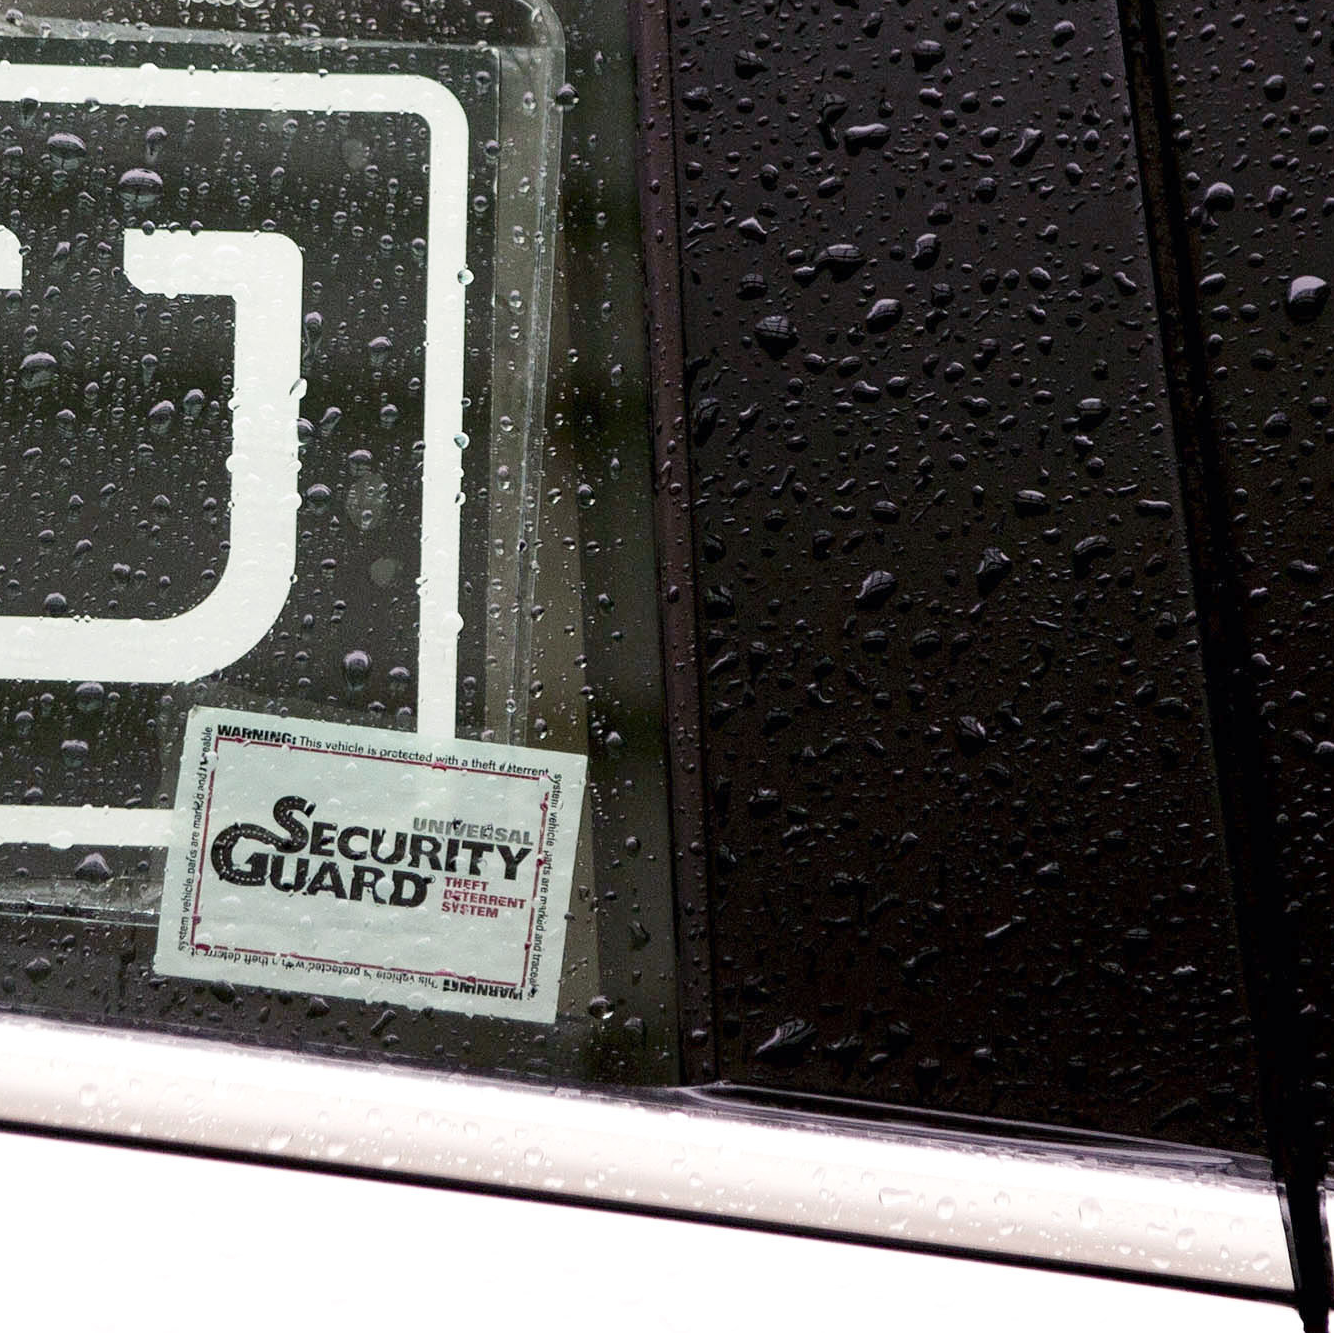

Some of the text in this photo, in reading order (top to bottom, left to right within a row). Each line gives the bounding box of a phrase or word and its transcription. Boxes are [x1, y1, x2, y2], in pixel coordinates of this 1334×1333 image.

[217, 724, 297, 745] WARNING:
[300, 735, 322, 749] This
[325, 740, 364, 754] vehicle
[367, 744, 377, 756] is
[380, 747, 433, 763] protected
[436, 753, 458, 766] with
[462, 759, 469, 767] a
[471, 758, 496, 772] theft
[197, 772, 208, 791] and
[272, 795, 533, 882] SECURITY
[413, 817, 534, 846] UNIVERSAL
[546, 812, 560, 846] vehicle
[191, 831, 200, 847] are
[211, 822, 429, 908] GUARD
[444, 877, 489, 891] THEFT
[540, 877, 550, 893] are
[182, 877, 195, 913] vehicle
[443, 889, 527, 909] DETERRENT
[441, 902, 499, 918] SYSTEM
[177, 917, 189, 951] system
[533, 933, 544, 952] and
[244, 954, 269, 967] theft
[308, 962, 361, 977] protected
